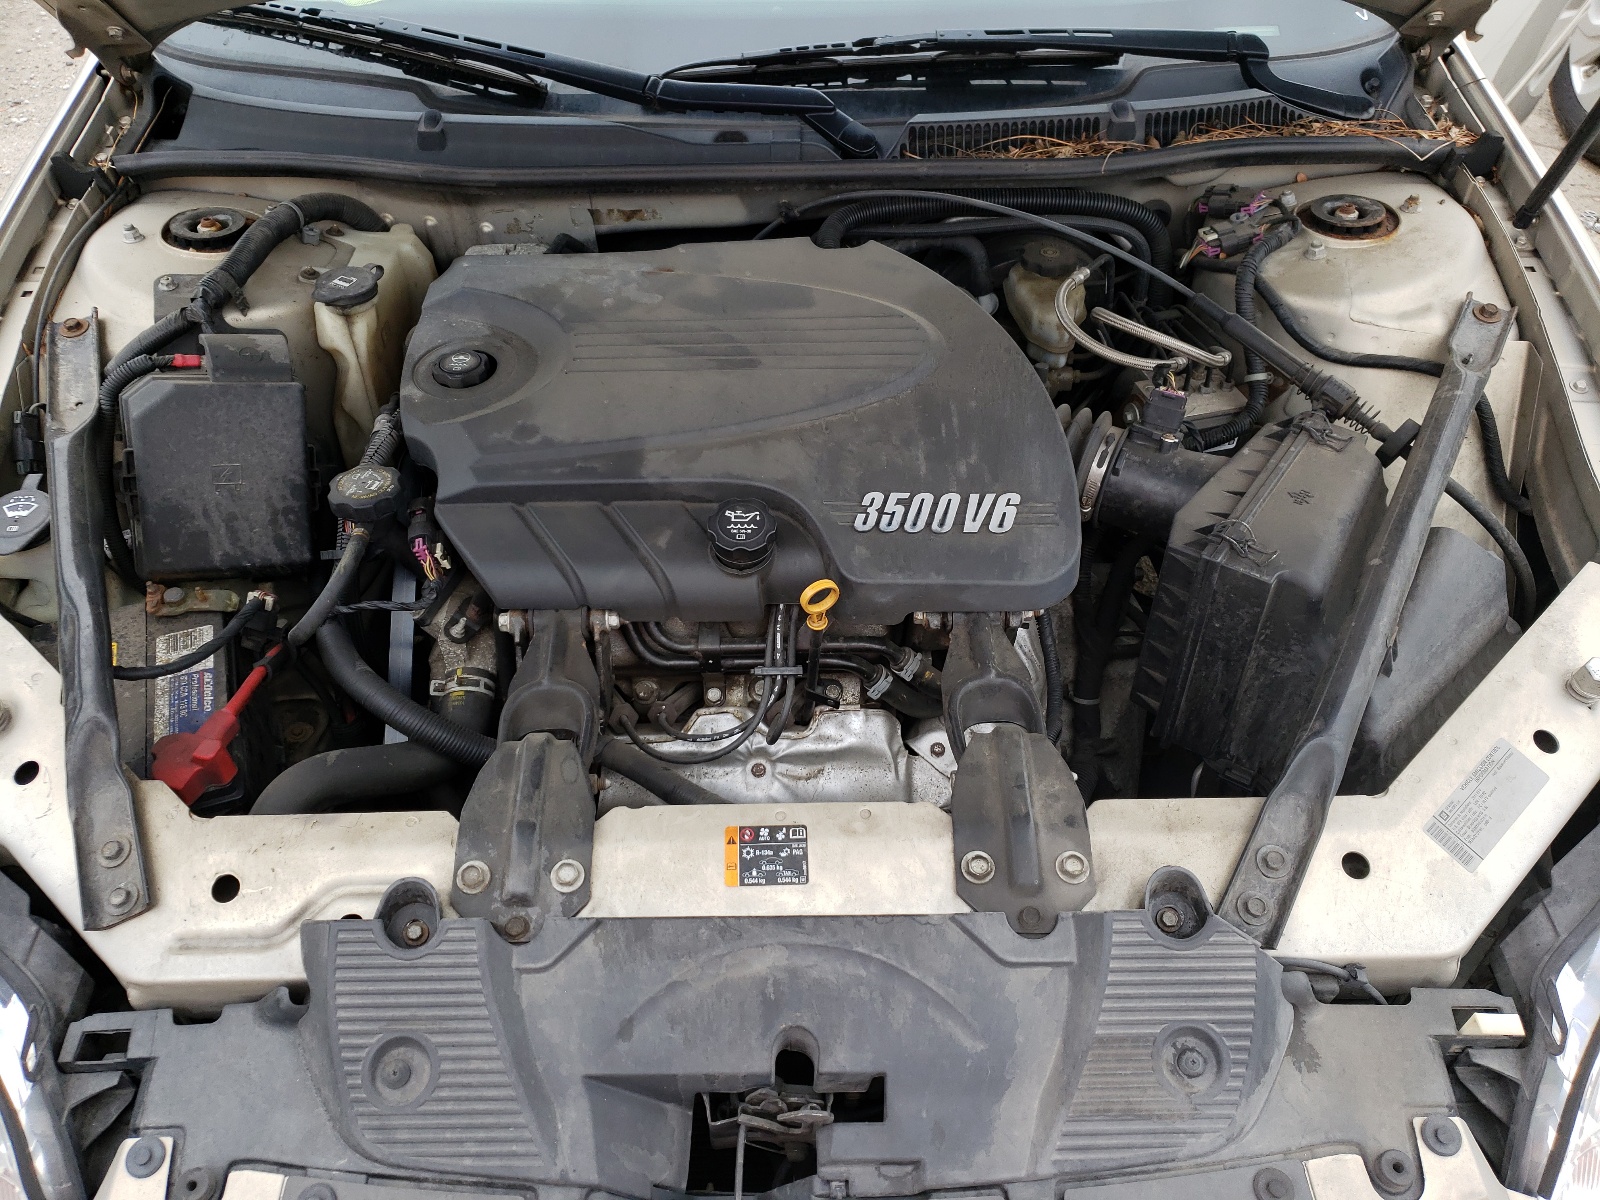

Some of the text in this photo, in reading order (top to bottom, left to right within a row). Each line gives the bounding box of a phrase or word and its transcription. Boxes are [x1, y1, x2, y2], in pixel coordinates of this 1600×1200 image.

[853, 491, 1021, 534] 3500 V6
[190, 673, 199, 711] Professional
[776, 864, 783, 872] kg
